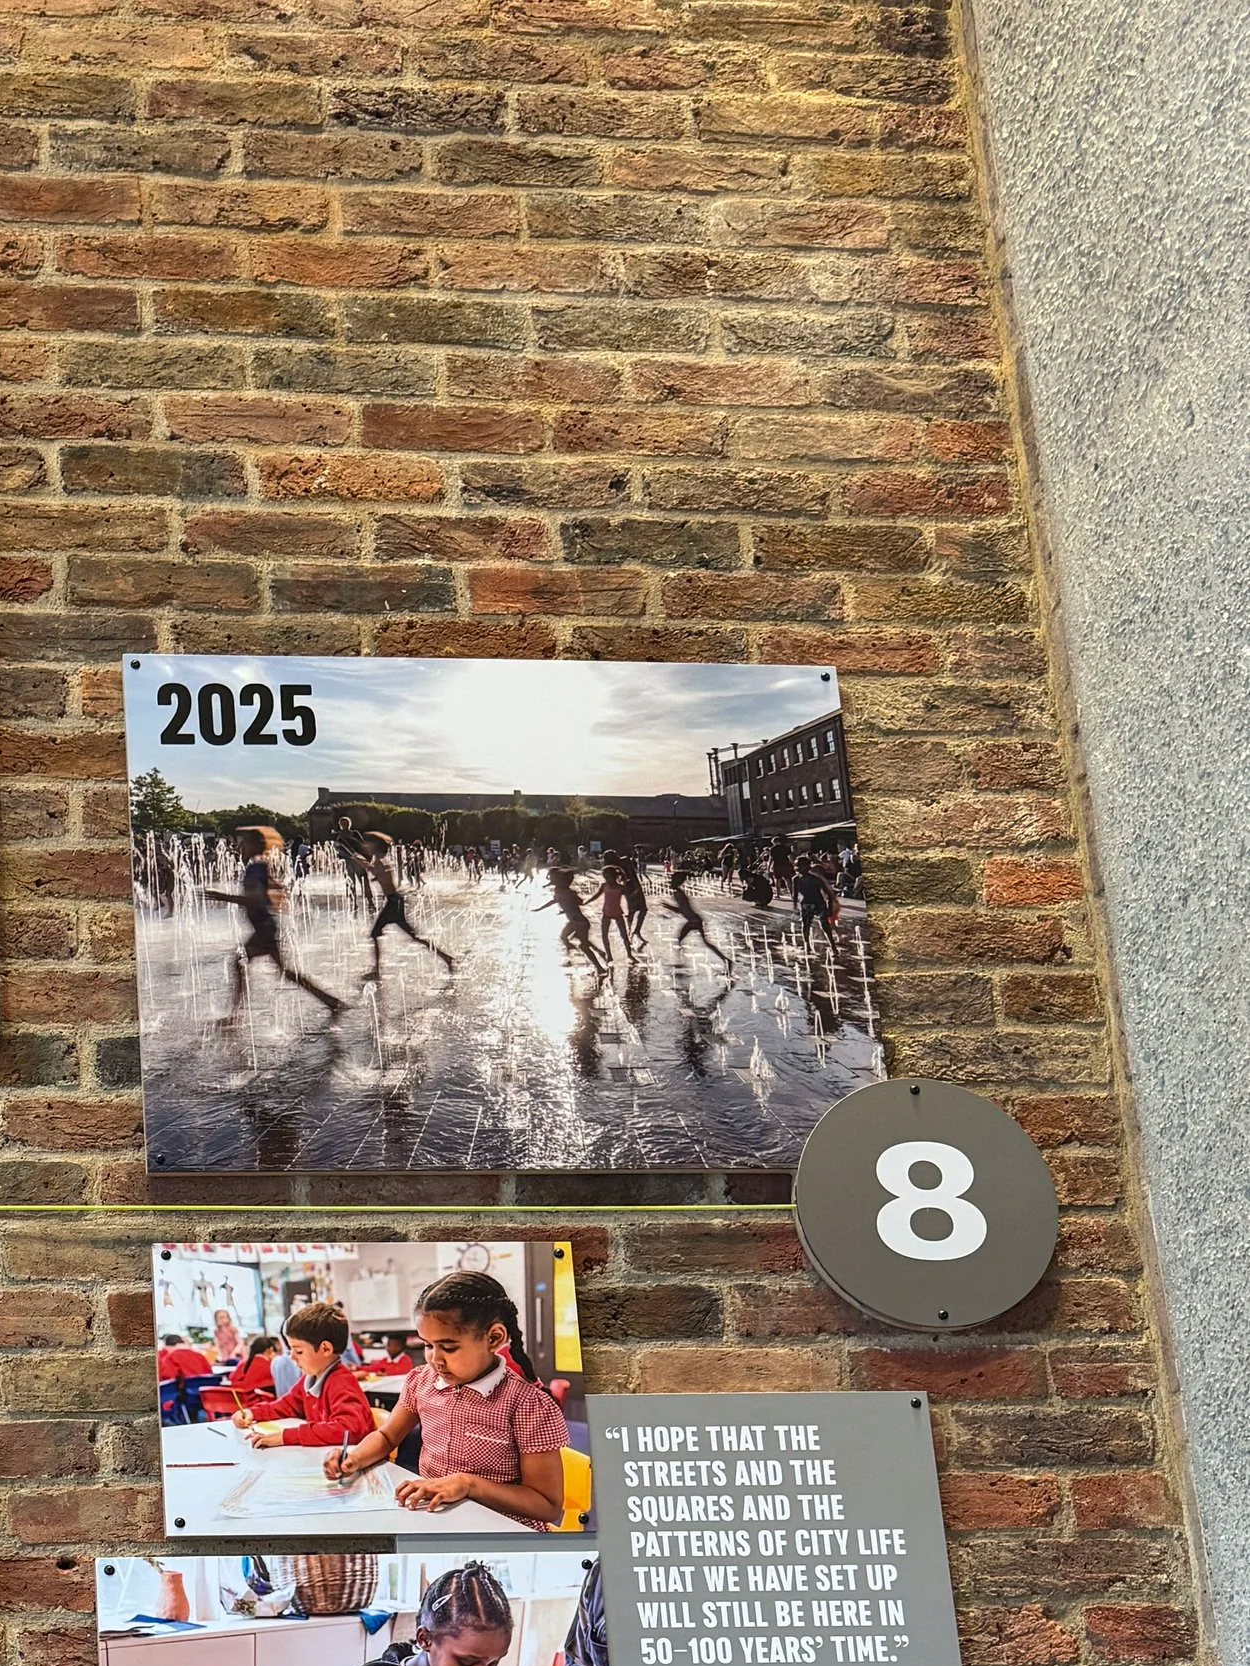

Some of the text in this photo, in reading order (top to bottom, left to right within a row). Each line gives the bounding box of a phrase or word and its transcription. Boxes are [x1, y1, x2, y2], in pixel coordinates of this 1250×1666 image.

[156, 682, 317, 747] 2025
[875, 1140, 988, 1262] 8
[636, 1426, 700, 1453] HOPE
[704, 1425, 767, 1452] THAT
[773, 1425, 821, 1451] THE
[623, 1459, 837, 1488] STREETS AND THE
[627, 1494, 845, 1528] SQUARES AND THE
[630, 1528, 907, 1558] PATTERNS OF CITY LIFE
[632, 1564, 898, 1593] THAT WE HAVE SET UP
[636, 1599, 905, 1629] WILL STILL BE HERE IN
